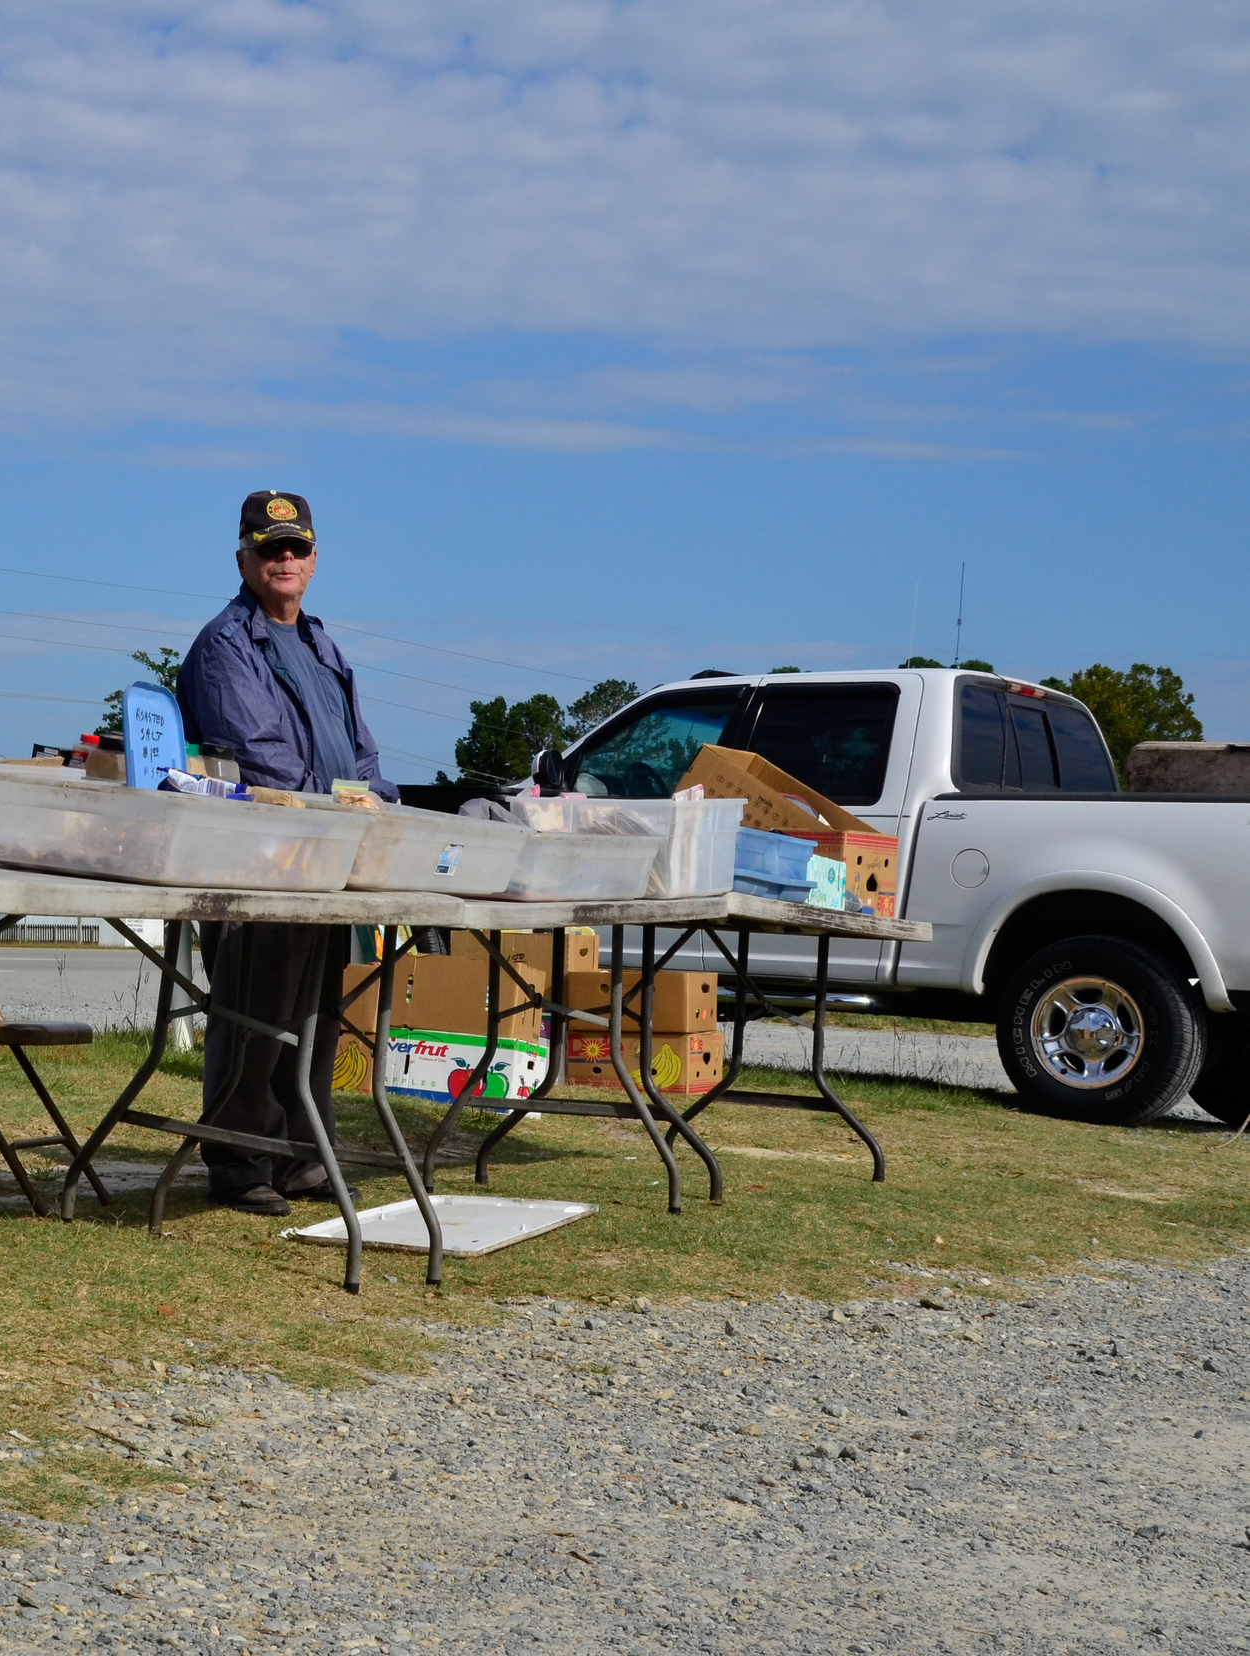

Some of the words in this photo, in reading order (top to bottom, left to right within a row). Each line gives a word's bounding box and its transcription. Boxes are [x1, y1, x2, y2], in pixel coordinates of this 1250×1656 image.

[135, 707, 165, 727] ROASTED
[140, 727, 164, 741] SALT
[1013, 960, 1072, 1078] MICHELIN
